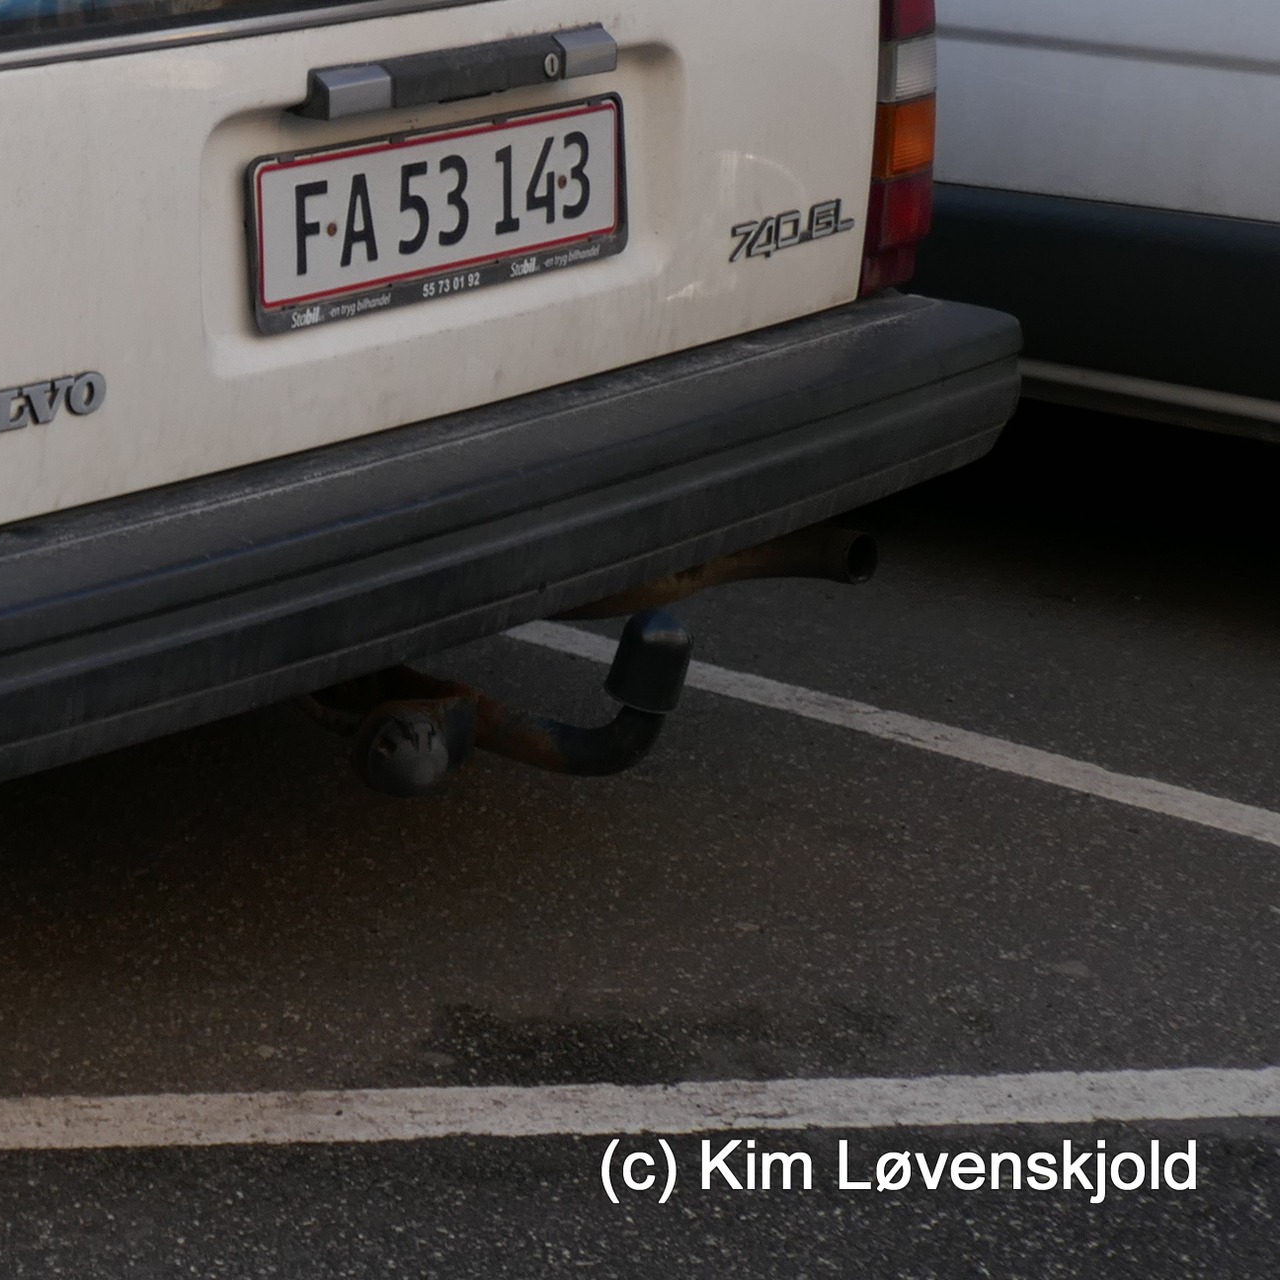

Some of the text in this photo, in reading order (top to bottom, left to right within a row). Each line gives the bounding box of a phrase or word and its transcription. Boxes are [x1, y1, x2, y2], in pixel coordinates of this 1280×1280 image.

[295, 131, 591, 275] FA 53 143
[729, 198, 855, 262] 740 GL
[422, 272, 480, 298] 55 73 01 92
